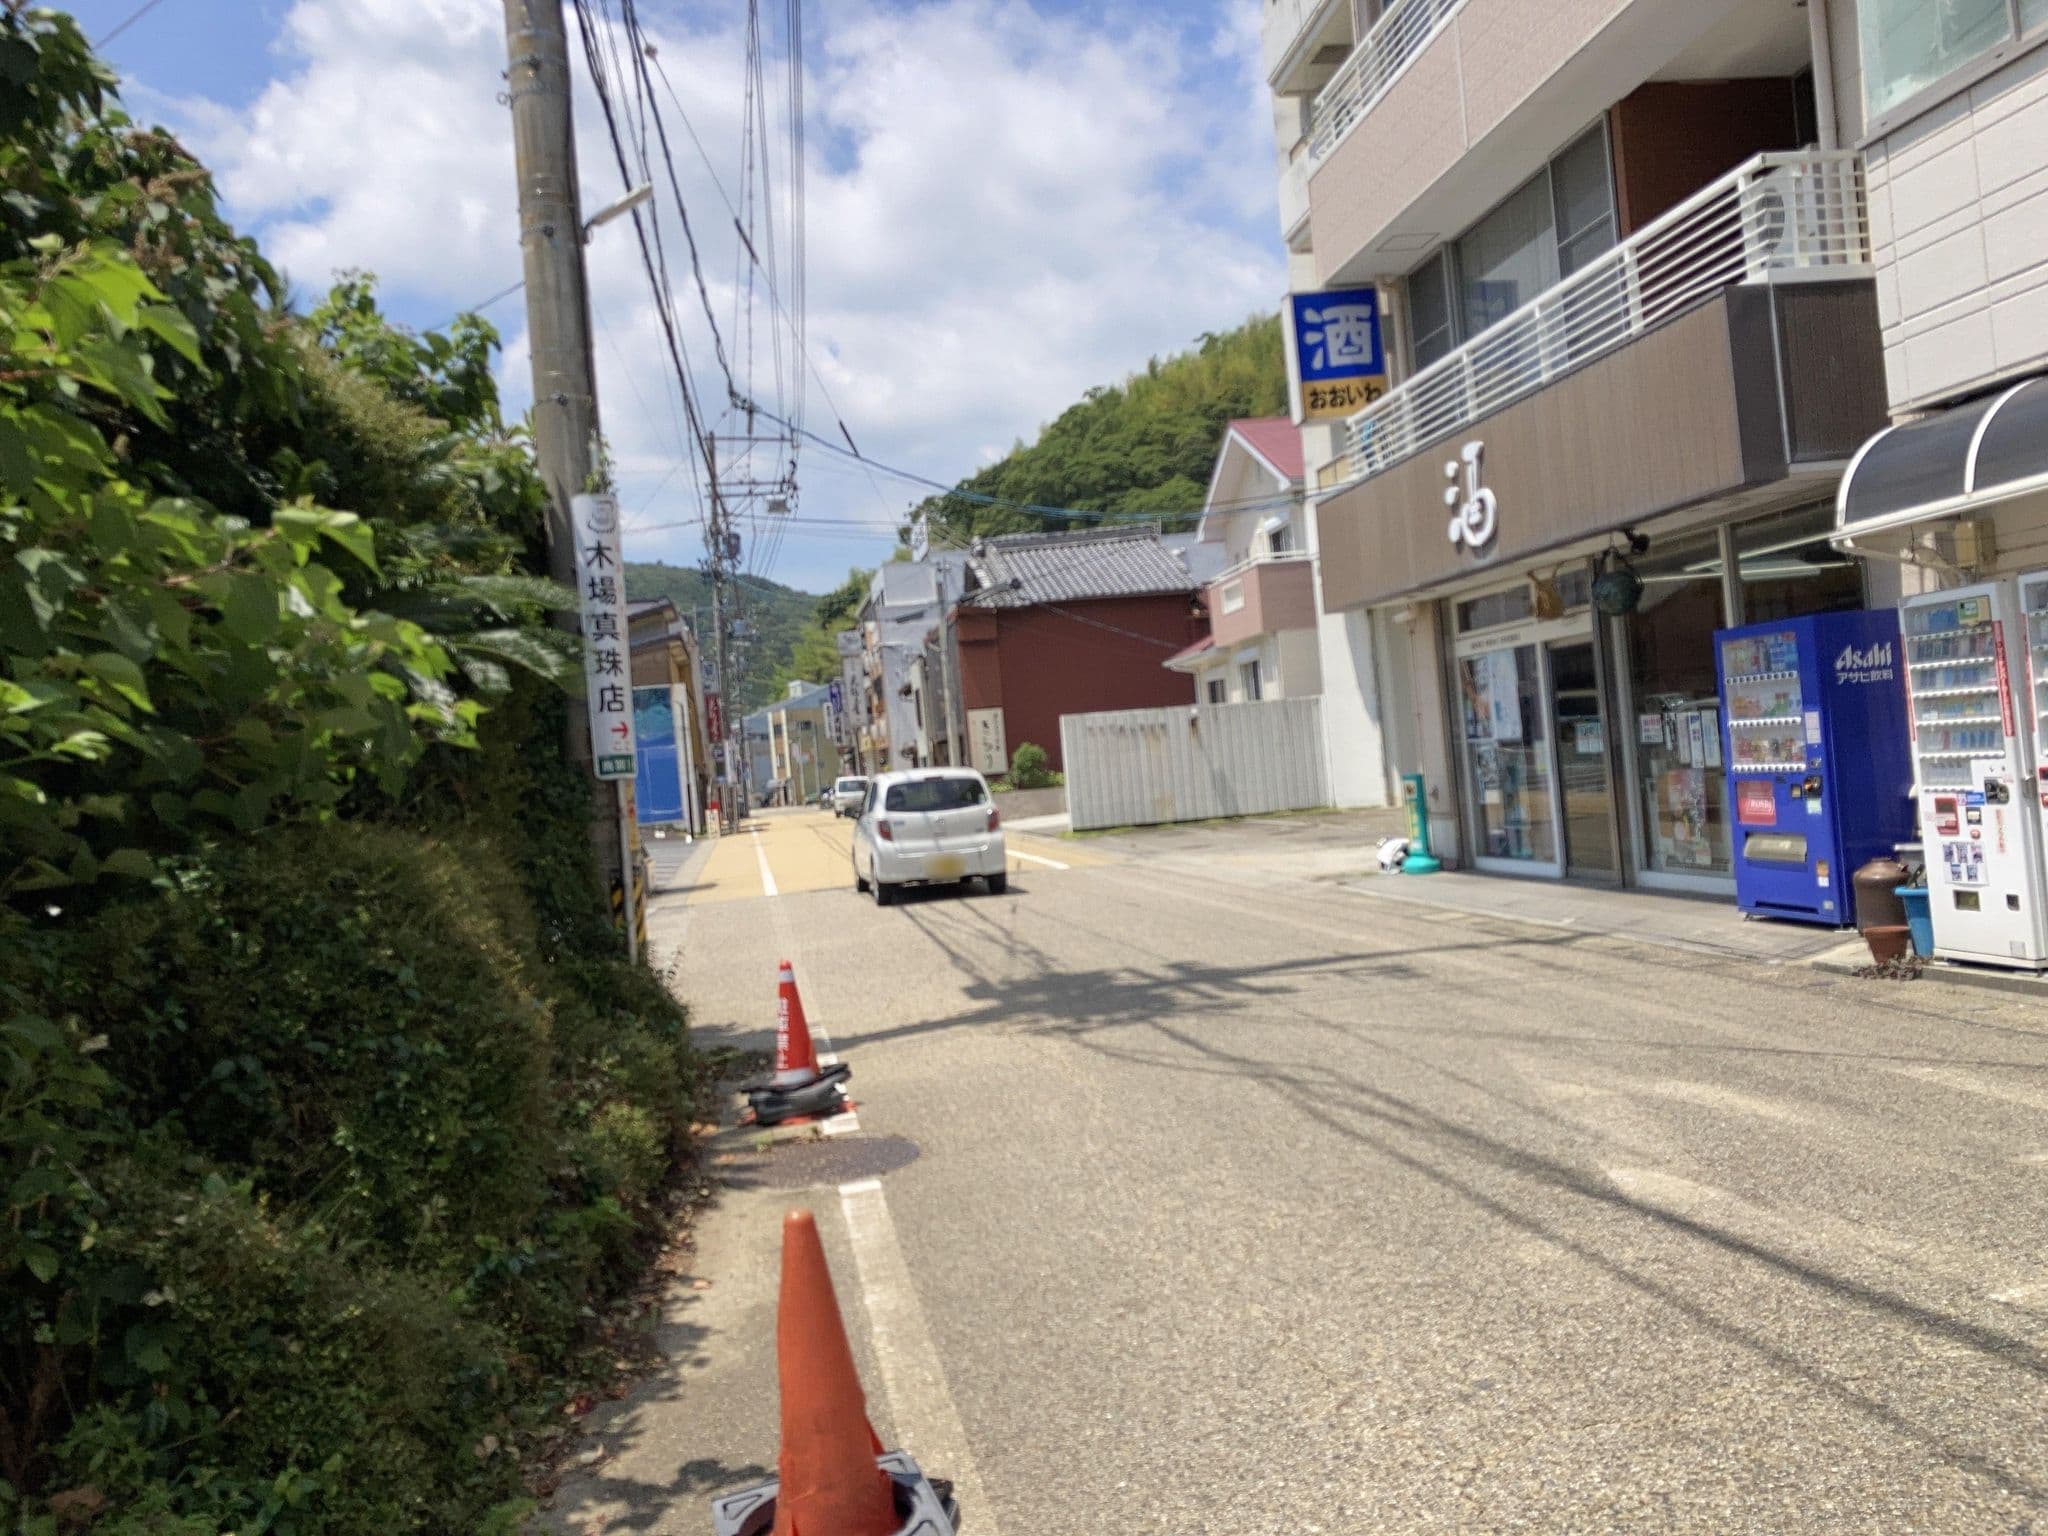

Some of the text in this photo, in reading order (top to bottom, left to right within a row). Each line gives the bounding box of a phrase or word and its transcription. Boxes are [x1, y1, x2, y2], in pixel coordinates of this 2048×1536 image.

[1303, 304, 1372, 370] 酒
[1309, 382, 1382, 409] おおいわ
[586, 541, 624, 713] 木場真珠店
[1835, 641, 1893, 670] Asahi
[1836, 669, 1893, 685] アサヒ飲料
